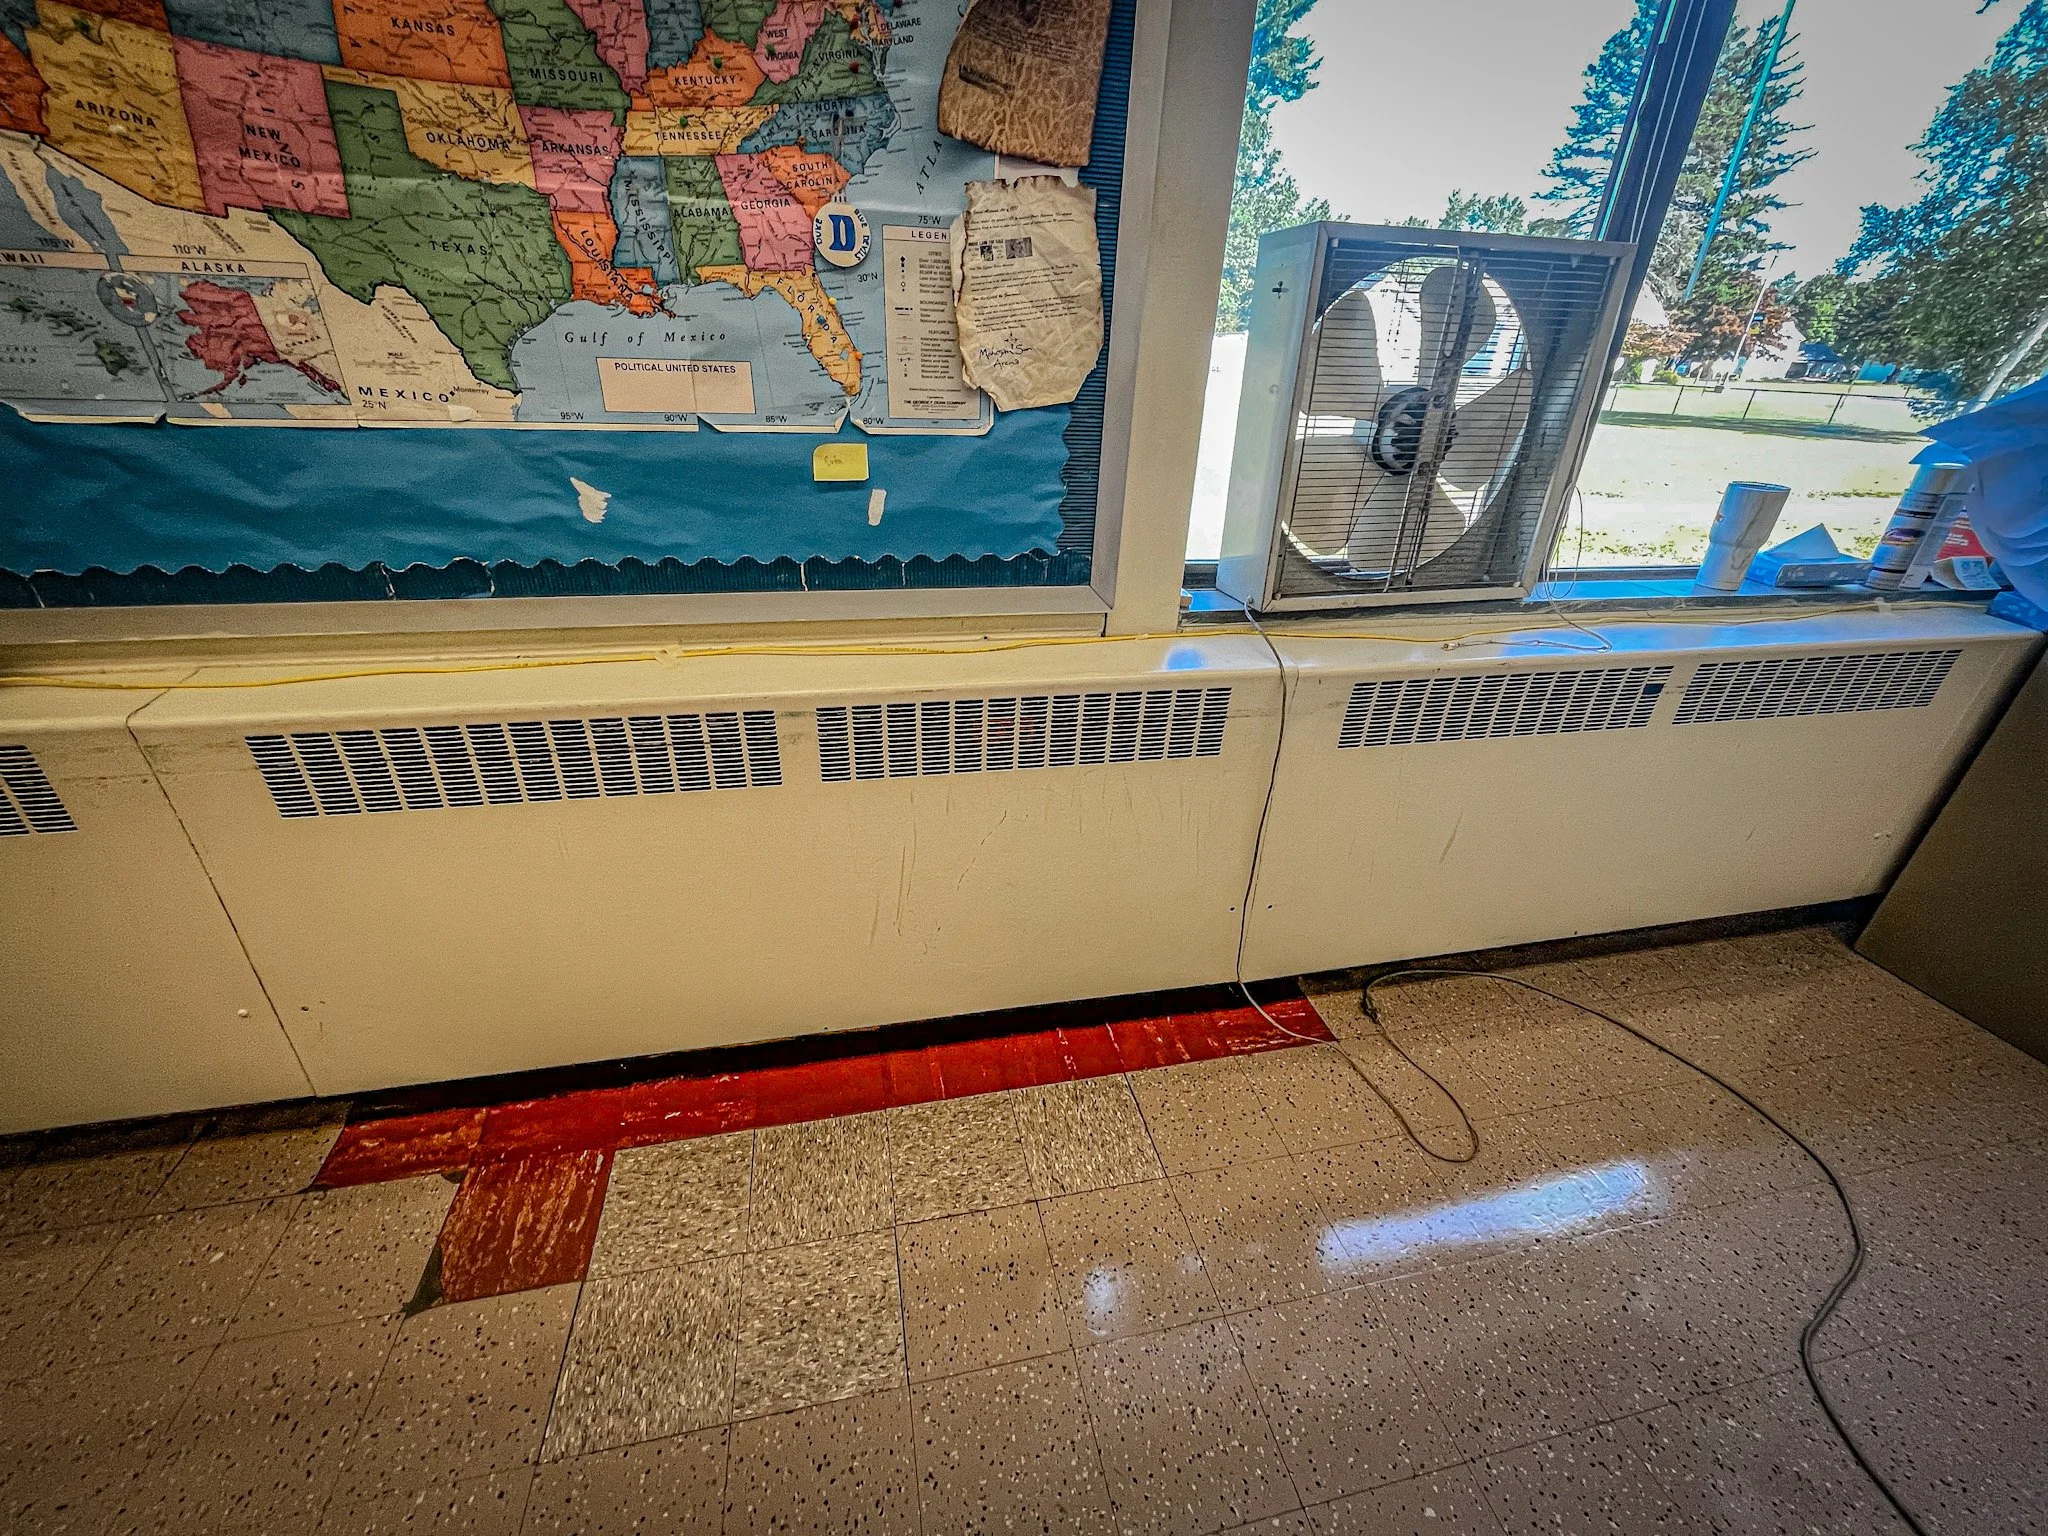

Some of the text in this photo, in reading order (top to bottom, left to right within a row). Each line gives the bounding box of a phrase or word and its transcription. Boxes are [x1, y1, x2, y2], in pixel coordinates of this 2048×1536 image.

[391, 17, 455, 36] KANSAS
[881, 17, 921, 31] DELAWARE
[765, 28, 788, 39] WEST
[871, 35, 914, 47] MARYLAND
[765, 51, 799, 62] VIRGINIA
[818, 49, 863, 62] VIRGINIA
[530, 68, 604, 83] MISSOURI
[674, 75, 735, 86] KENTUCKY
[75, 99, 156, 128] ARIZONA
[245, 124, 281, 141] NEW
[654, 131, 722, 141] TENNESSEE
[426, 132, 510, 150] OKLAHOMA
[541, 142, 609, 156] ARKANSAS
[238, 146, 301, 168] MEXICO
[792, 161, 829, 173] SOUTH
[786, 177, 840, 190] CAROLINA
[740, 198, 792, 211] GEORGIA
[672, 207, 729, 218] ALABAMA
[853, 208, 868, 229] BLUE
[918, 215, 942, 226] 75°W
[815, 219, 823, 245] DUKE
[828, 214, 857, 252] D
[911, 230, 950, 240] LEGEN
[172, 244, 207, 255] 110°W
[429, 240, 488, 256] TEXAS
[854, 235, 870, 262] DEVILS
[1, 252, 45, 264] WAII
[181, 261, 247, 274] ALASKA
[580, 229, 634, 301] LOUISIANA
[857, 271, 878, 283] 30°N
[776, 277, 838, 344] FLORDA
[565, 331, 726, 346] Gulf of Mexico
[614, 362, 736, 374] POLITICAL UNITED STATES
[358, 386, 449, 403] MEXICO
[560, 412, 585, 420] 95°W
[664, 413, 688, 422] 90°W
[765, 415, 788, 424] 85°W
[862, 417, 884, 426] 80°W
